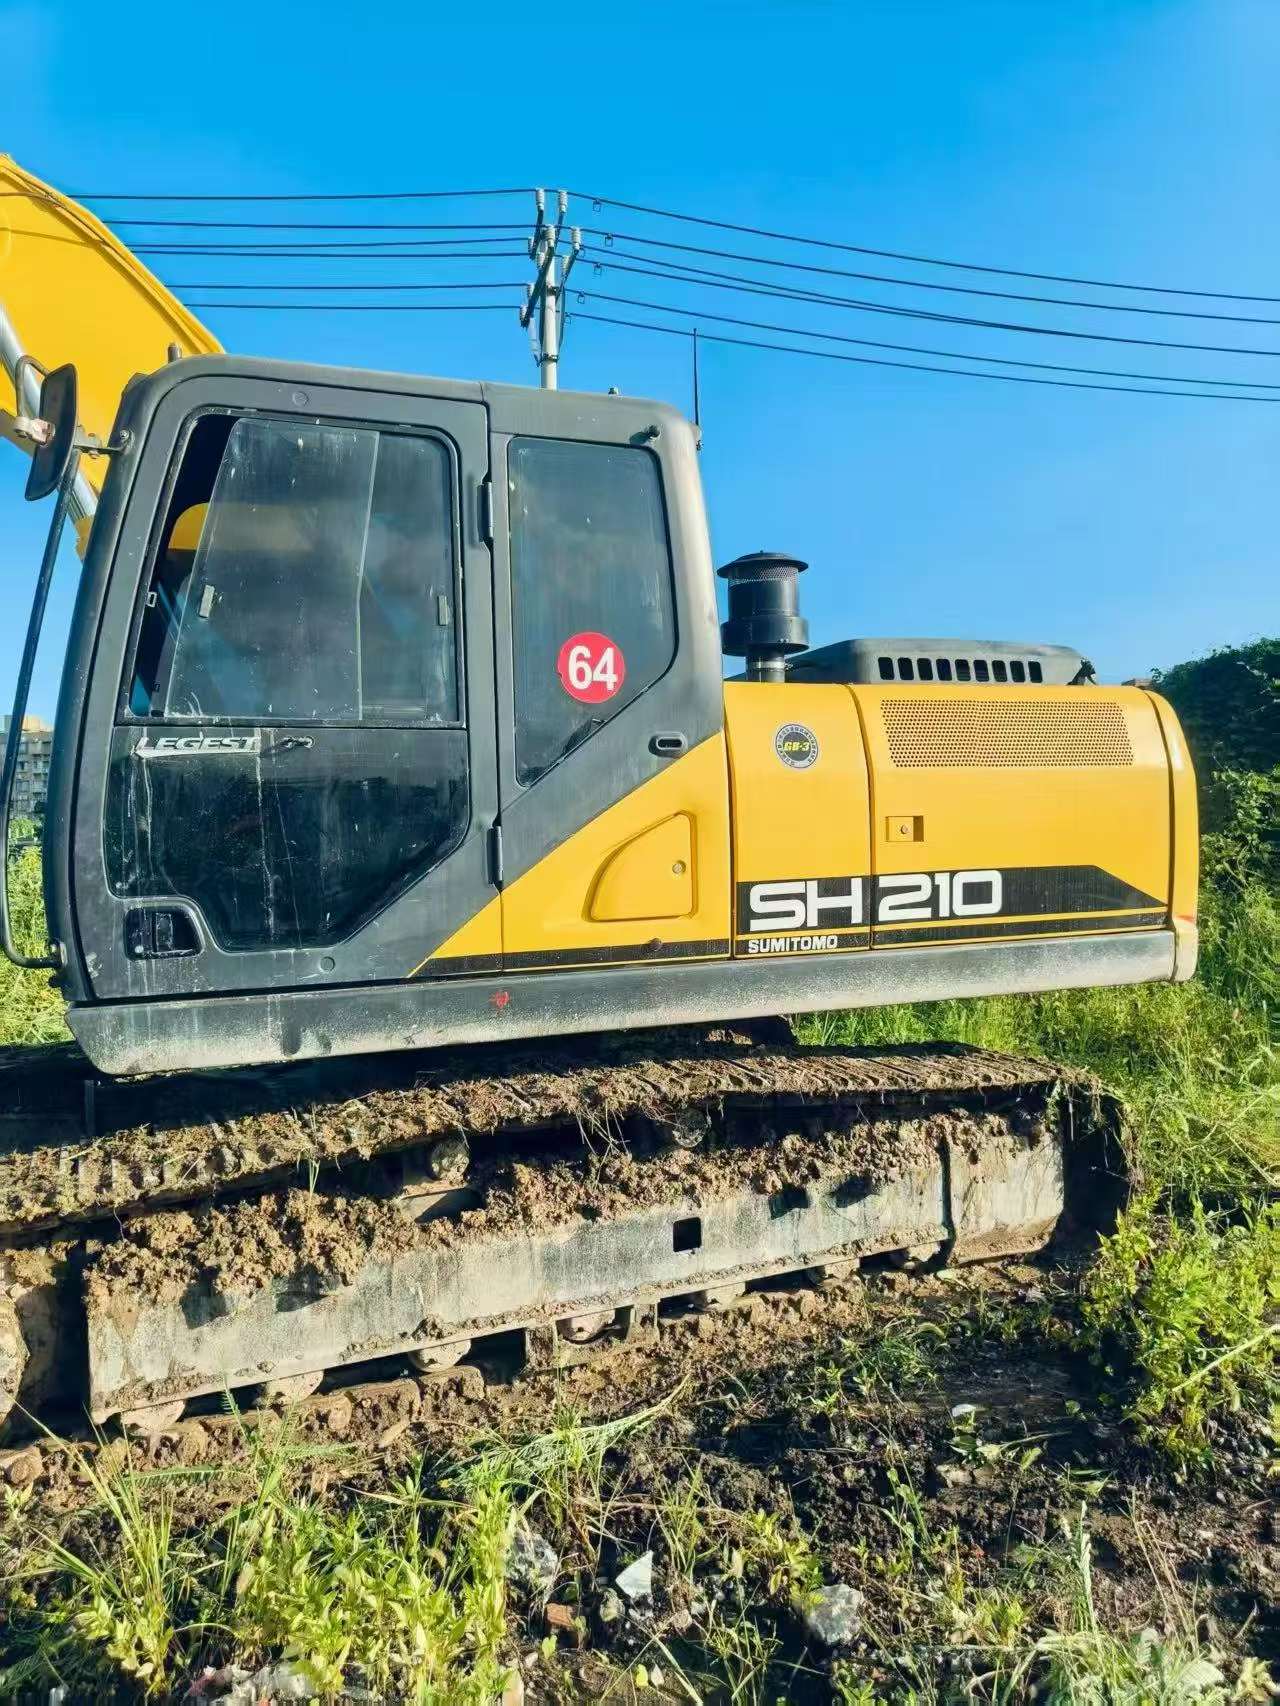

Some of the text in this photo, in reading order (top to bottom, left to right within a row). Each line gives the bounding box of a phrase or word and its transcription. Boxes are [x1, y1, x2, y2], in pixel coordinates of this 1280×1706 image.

[568, 645, 618, 690] 64
[134, 736, 261, 756] LEGEST
[749, 869, 1002, 932] SH 210
[748, 935, 838, 954] SUMITOMO
